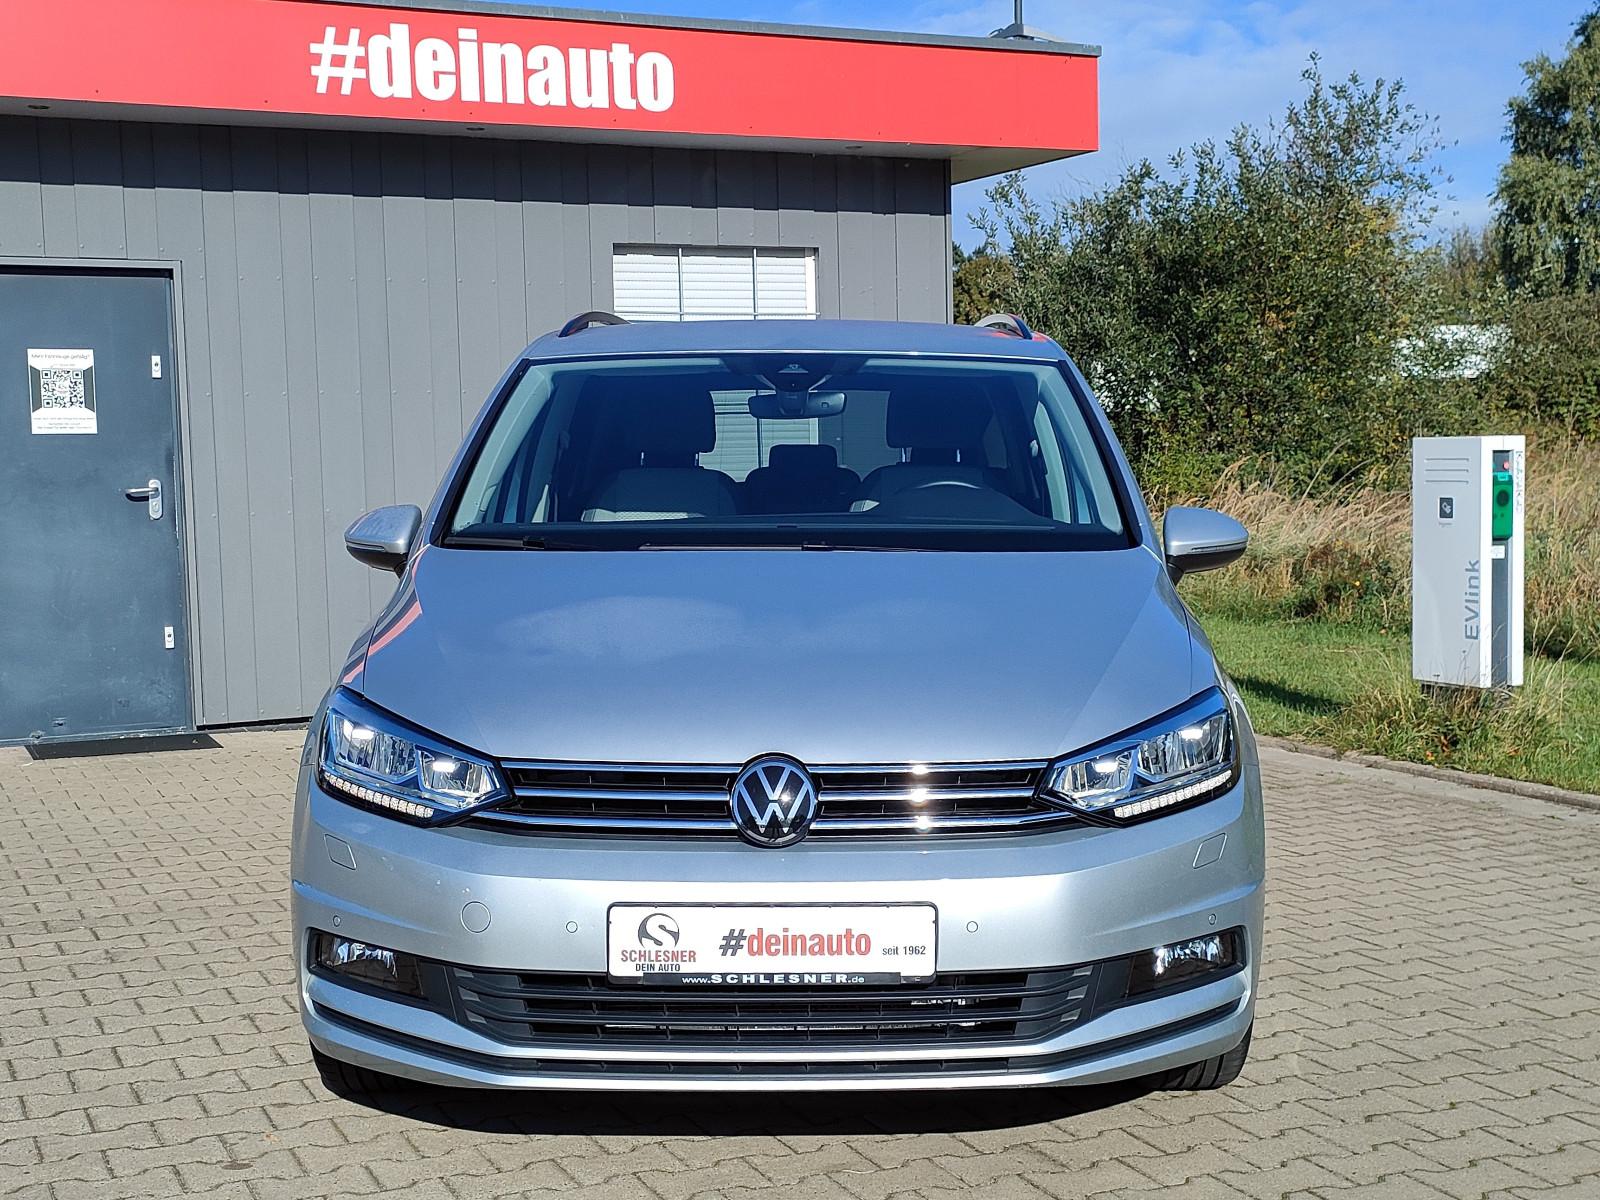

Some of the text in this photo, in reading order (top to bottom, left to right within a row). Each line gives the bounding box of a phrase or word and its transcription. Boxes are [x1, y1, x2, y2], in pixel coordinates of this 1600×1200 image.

[309, 23, 675, 113] #deinauto
[1464, 560, 1479, 640] EVlink
[719, 927, 872, 957] #deinauto
[620, 949, 697, 963] SCHLESNER
[882, 945, 926, 956] seit 1962
[635, 963, 681, 972] DEIN AUTO
[681, 973, 865, 985] www.SCHLESNER.de
